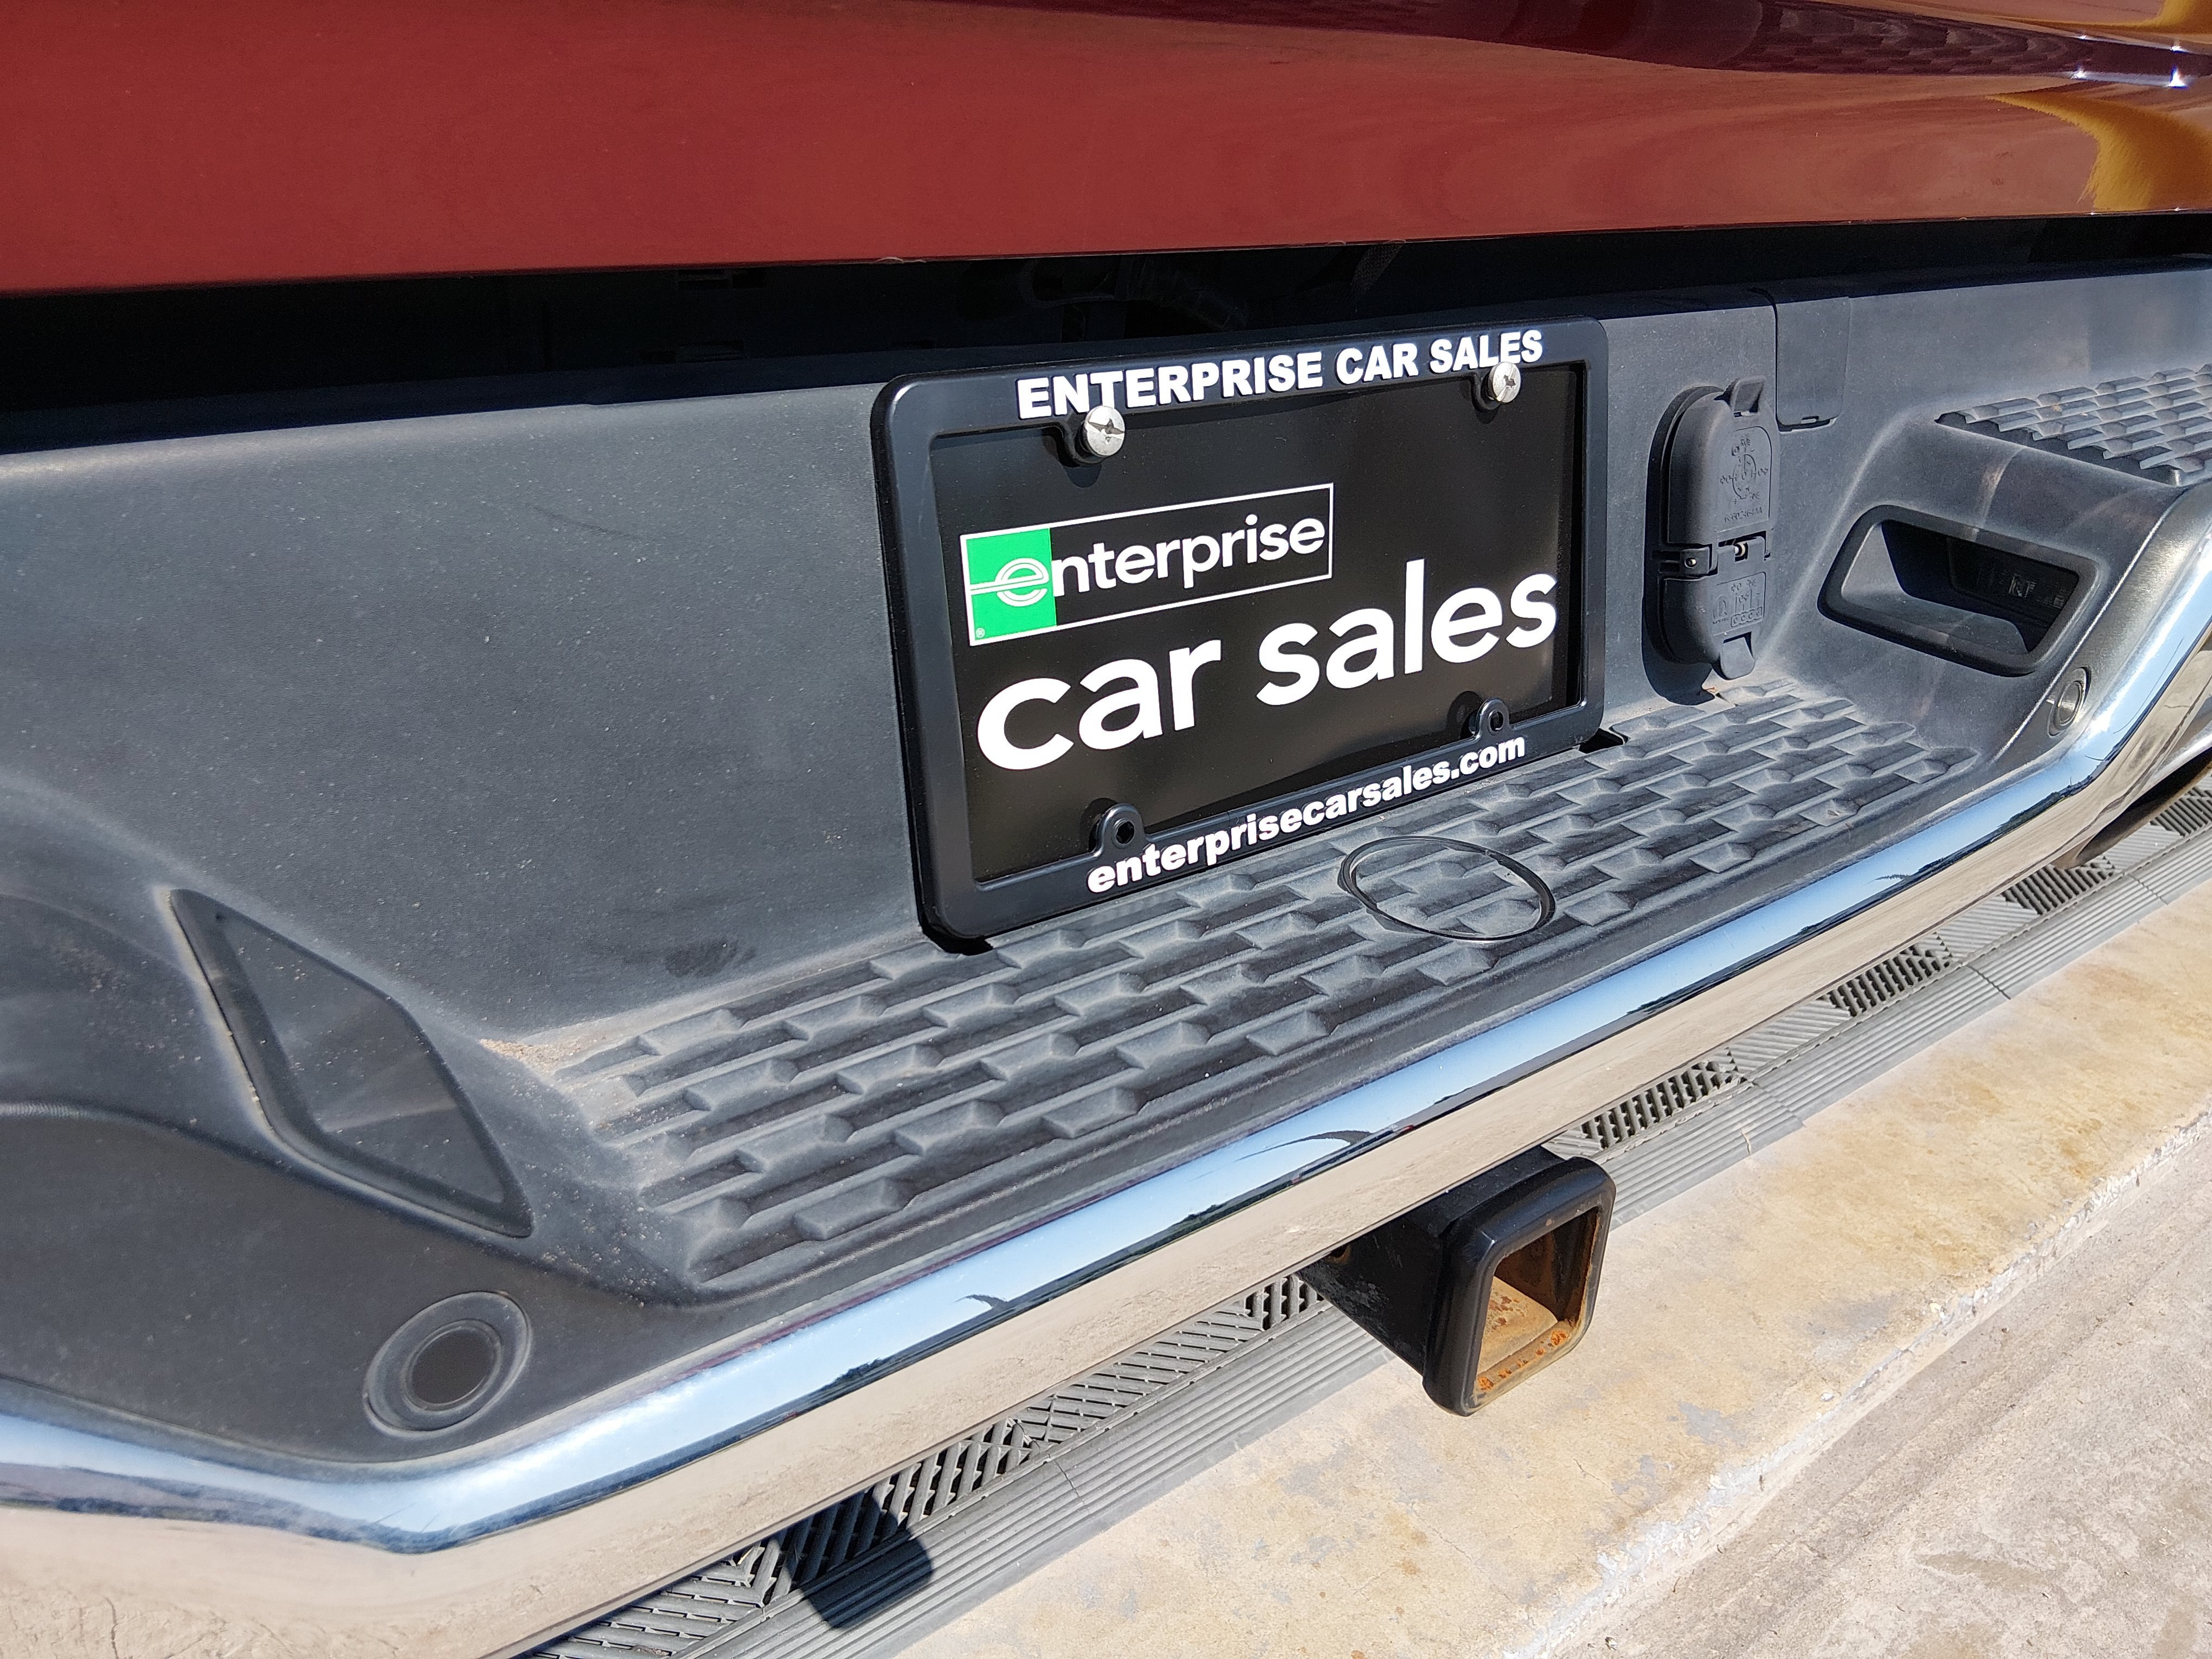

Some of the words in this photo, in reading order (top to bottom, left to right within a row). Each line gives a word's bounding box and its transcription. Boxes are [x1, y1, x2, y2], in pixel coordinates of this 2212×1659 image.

[1017, 351, 1323, 420] ENTERPRISE
[1336, 347, 1418, 384] CAR
[1430, 330, 1542, 373] SALES
[970, 514, 1324, 607] enterprise
[977, 639, 1221, 770] car
[1256, 559, 1557, 705] sales
[1087, 736, 1525, 893] enterprisecarsales.com
